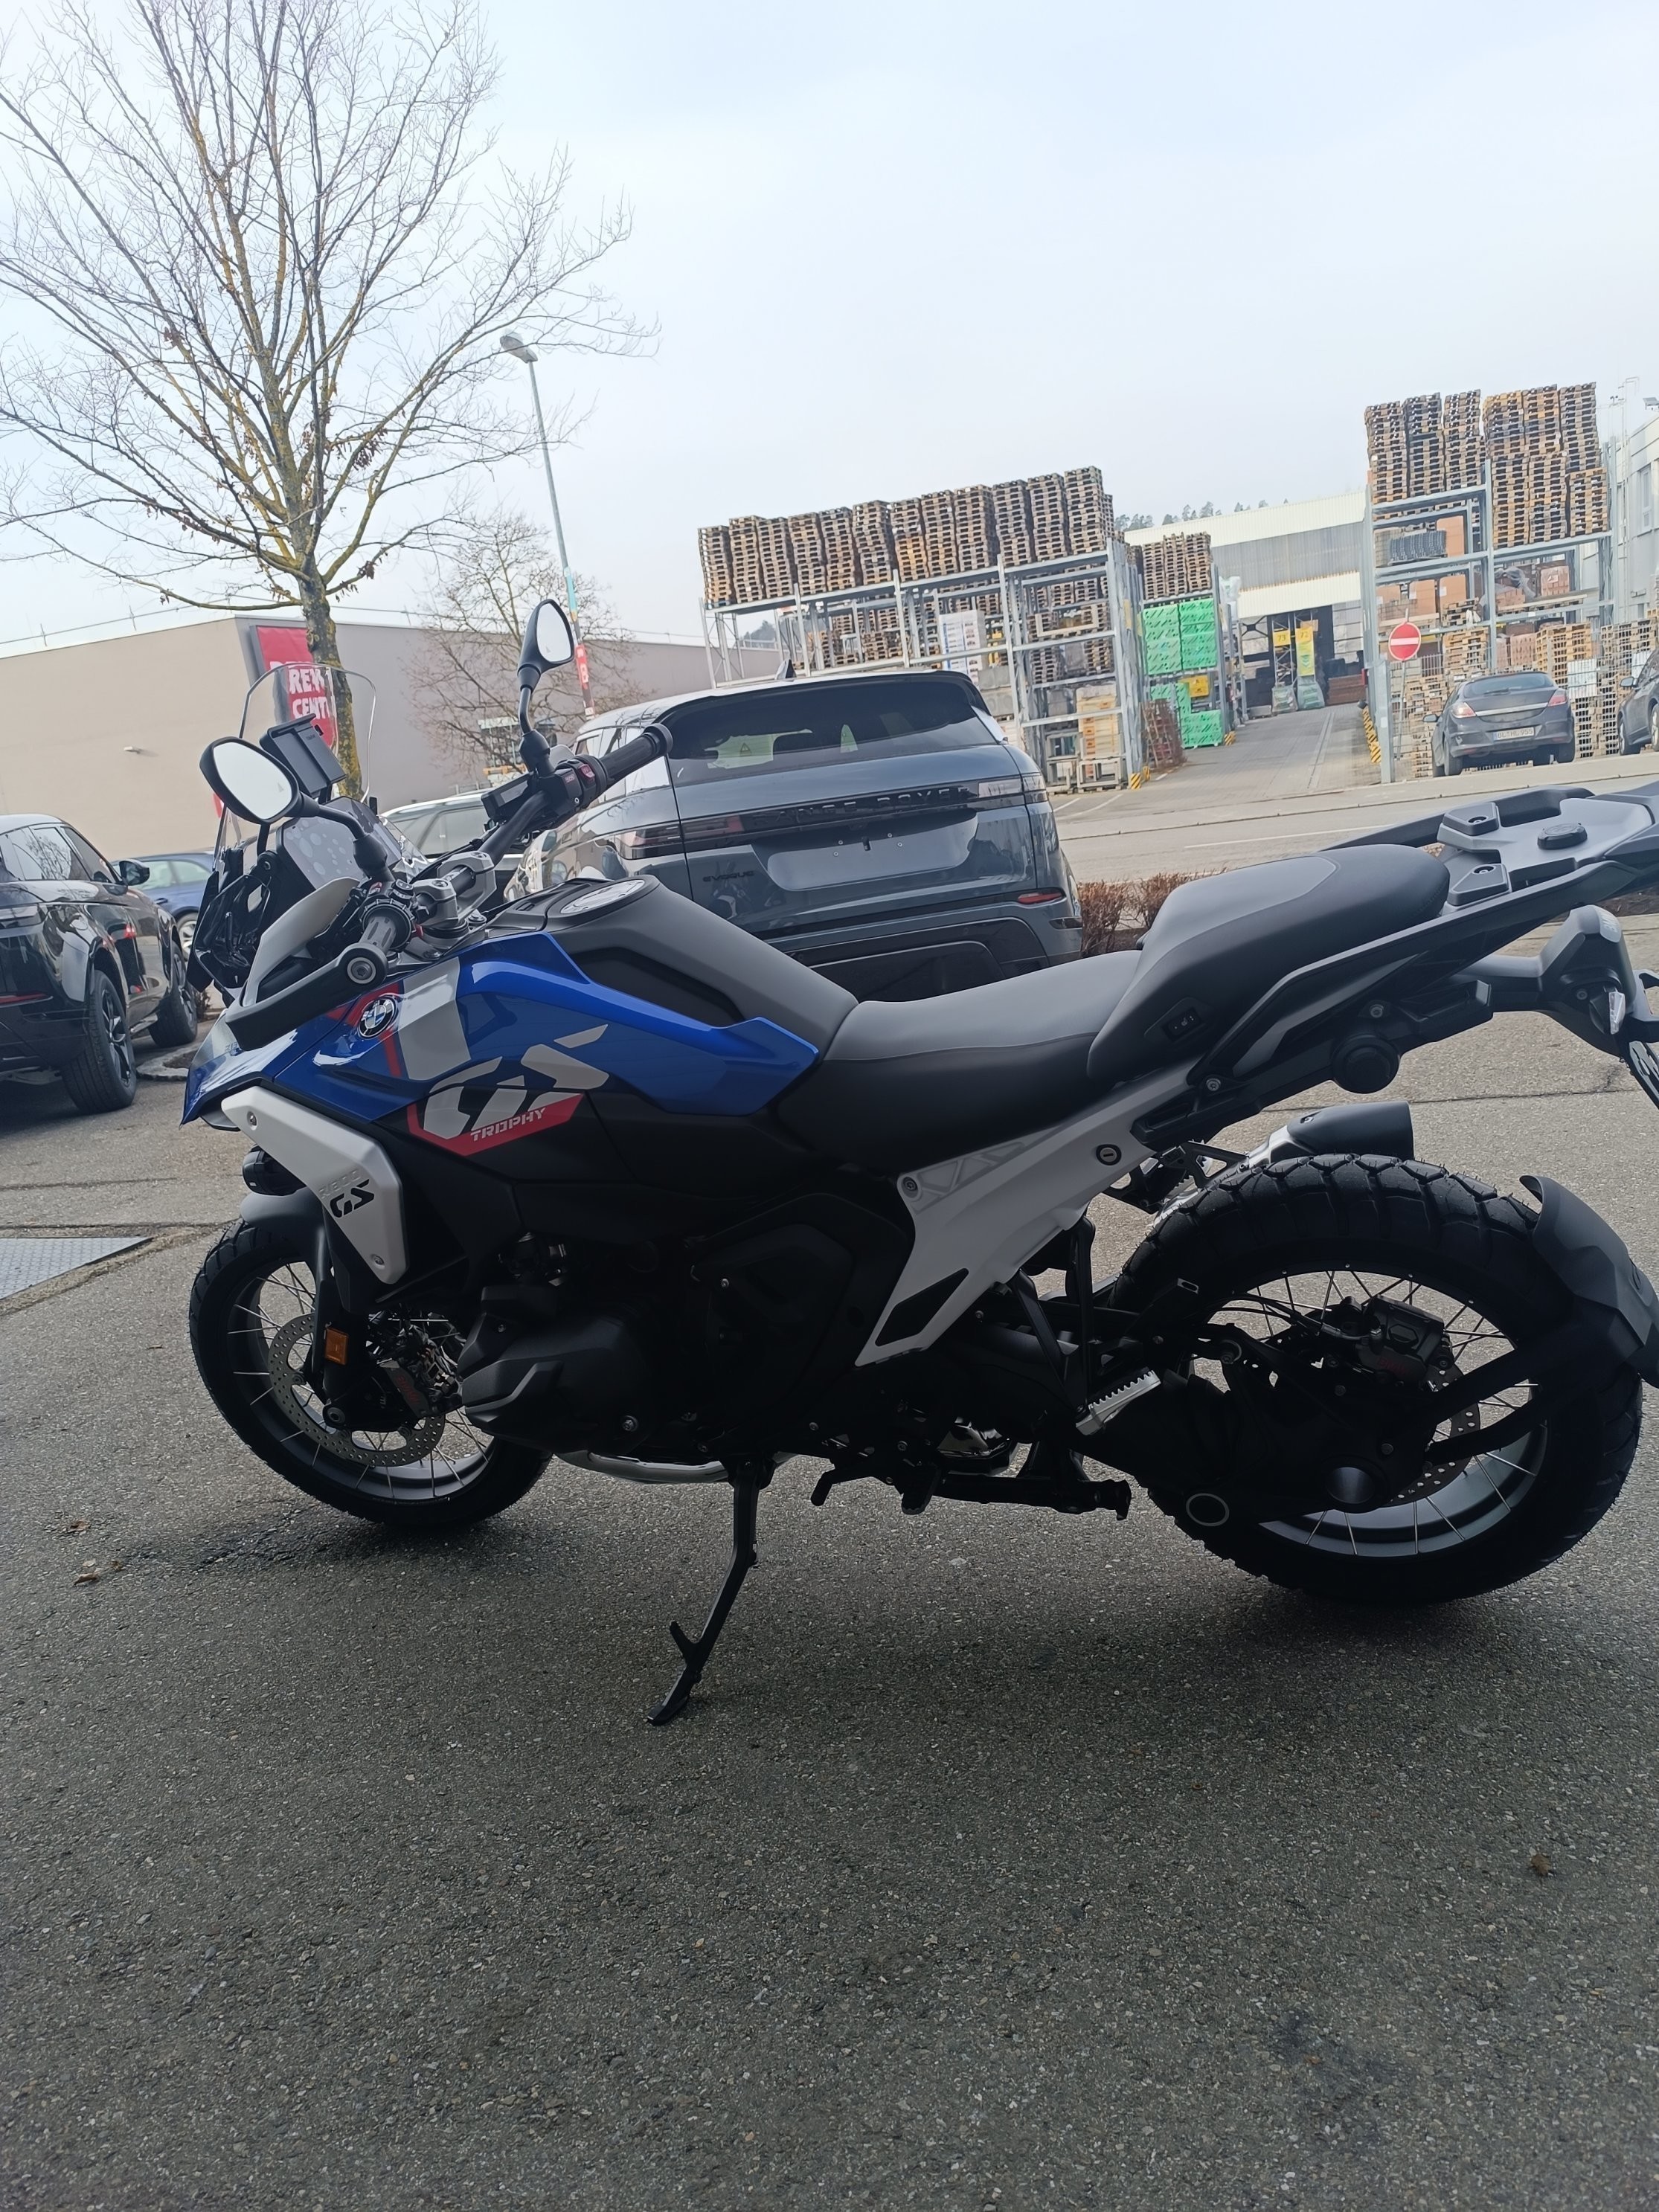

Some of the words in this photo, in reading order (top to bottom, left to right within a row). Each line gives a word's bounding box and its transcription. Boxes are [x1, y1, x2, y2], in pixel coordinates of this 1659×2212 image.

[289, 668, 325, 694] REW
[753, 801, 856, 824] RANGE
[877, 787, 970, 808] ROVER
[702, 870, 754, 882] EVOQUE
[423, 1023, 609, 1139] GS
[470, 1107, 546, 1142] TROPHY
[330, 1179, 374, 1218] GS
